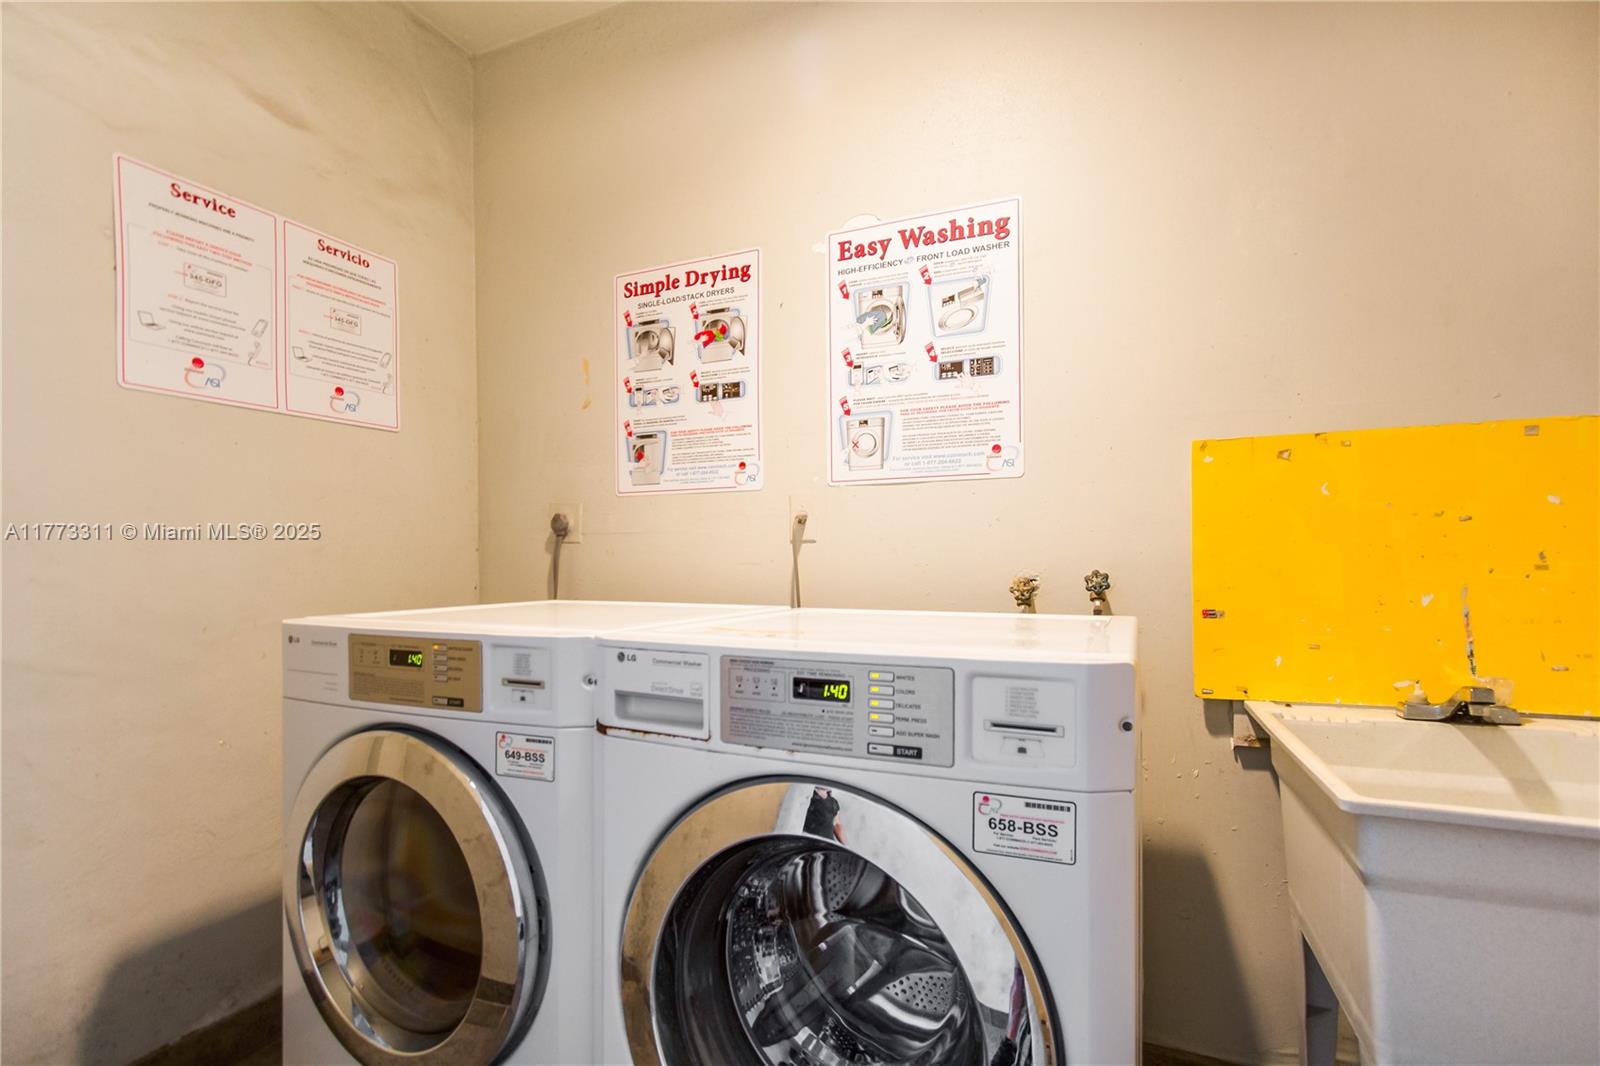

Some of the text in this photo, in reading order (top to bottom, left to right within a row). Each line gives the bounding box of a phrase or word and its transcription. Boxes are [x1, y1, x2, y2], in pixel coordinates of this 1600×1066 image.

[170, 182, 236, 218] Service
[838, 216, 1010, 261] Easy Washing
[317, 239, 370, 269] Servicio
[838, 259, 903, 277] HIGH-EFFICIENCY
[916, 252, 944, 263] FRONT
[946, 248, 971, 258] LOAD
[972, 241, 1010, 253] WASHER
[624, 263, 751, 298] Simple Drying
[637, 291, 704, 309] SINGLE-LOAD/STACK
[705, 286, 735, 298] DRYERS
[627, 653, 637, 662] LG
[823, 684, 849, 700] 1.40
[505, 750, 545, 763] 649-BSS
[896, 748, 919, 757] START
[988, 817, 1059, 837] 658-BSS
